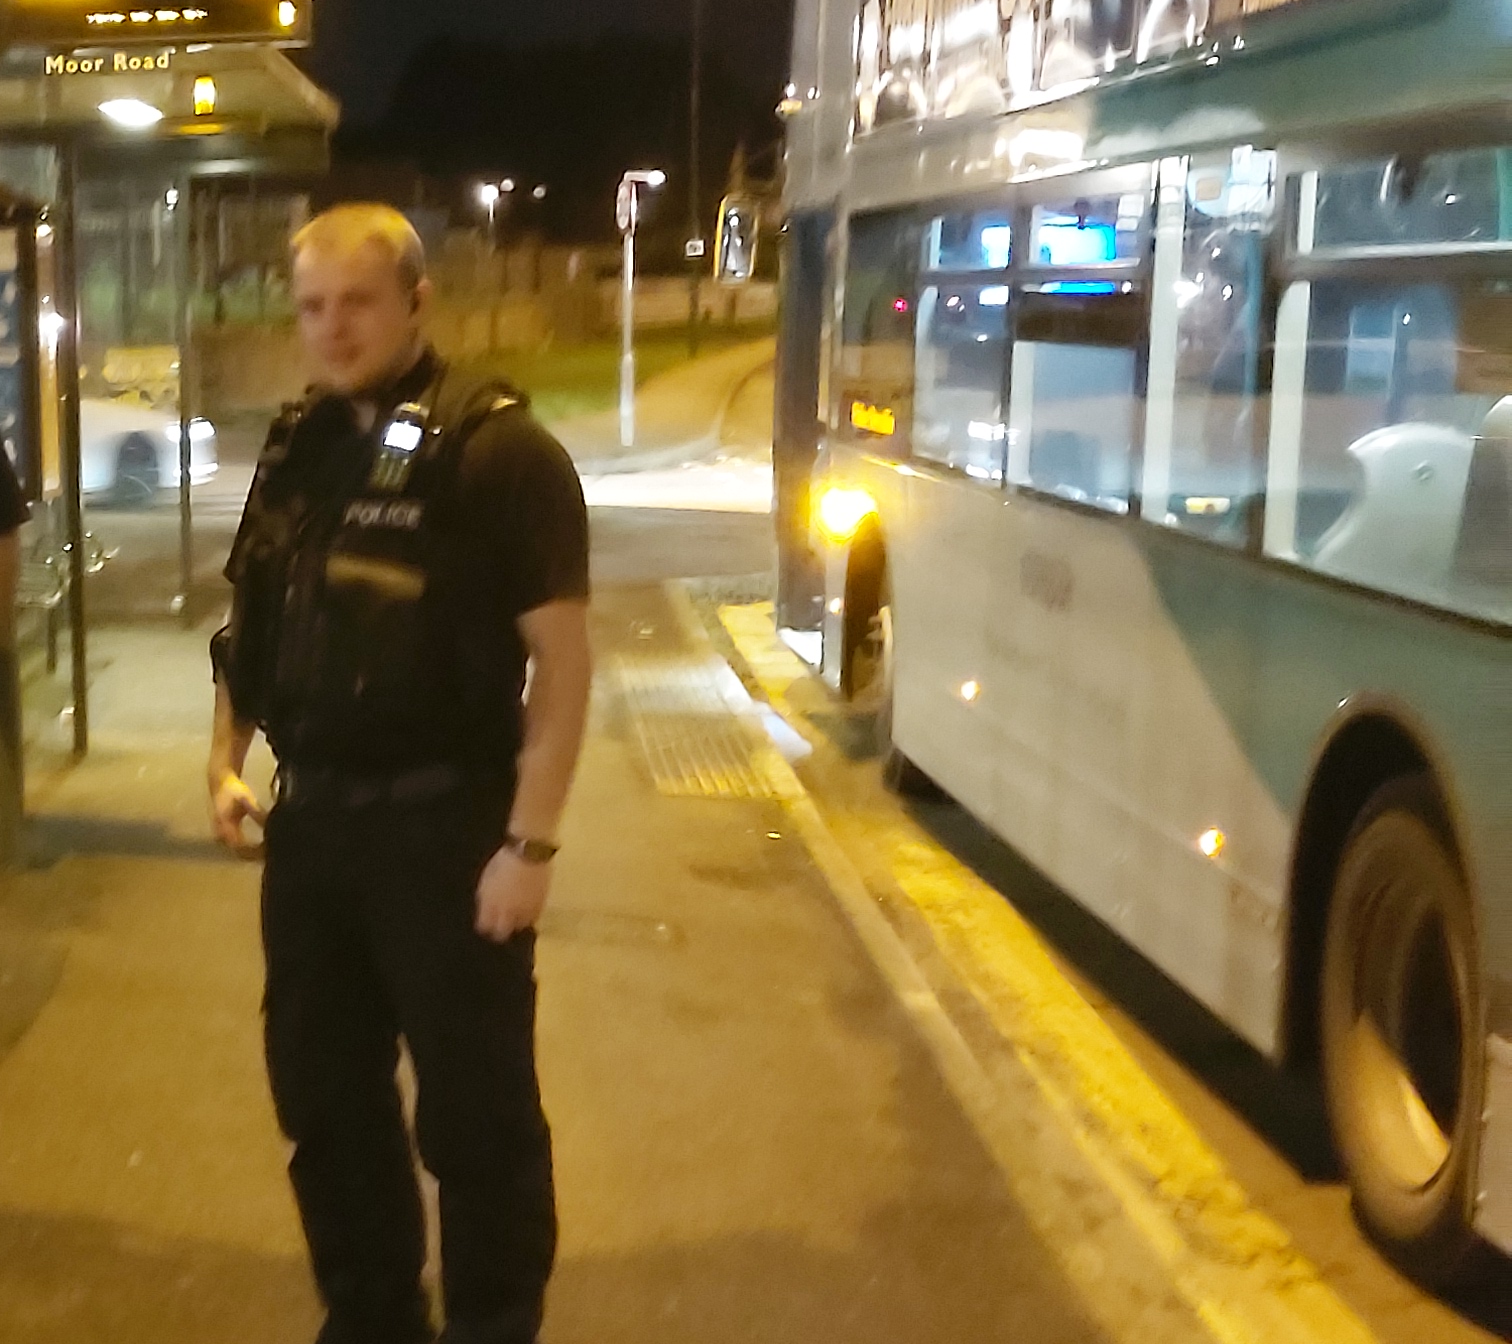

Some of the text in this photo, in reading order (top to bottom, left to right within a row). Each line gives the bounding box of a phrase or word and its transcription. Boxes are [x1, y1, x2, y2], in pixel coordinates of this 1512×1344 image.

[45, 51, 171, 75] Moor Road
[345, 502, 422, 529] POLICE
